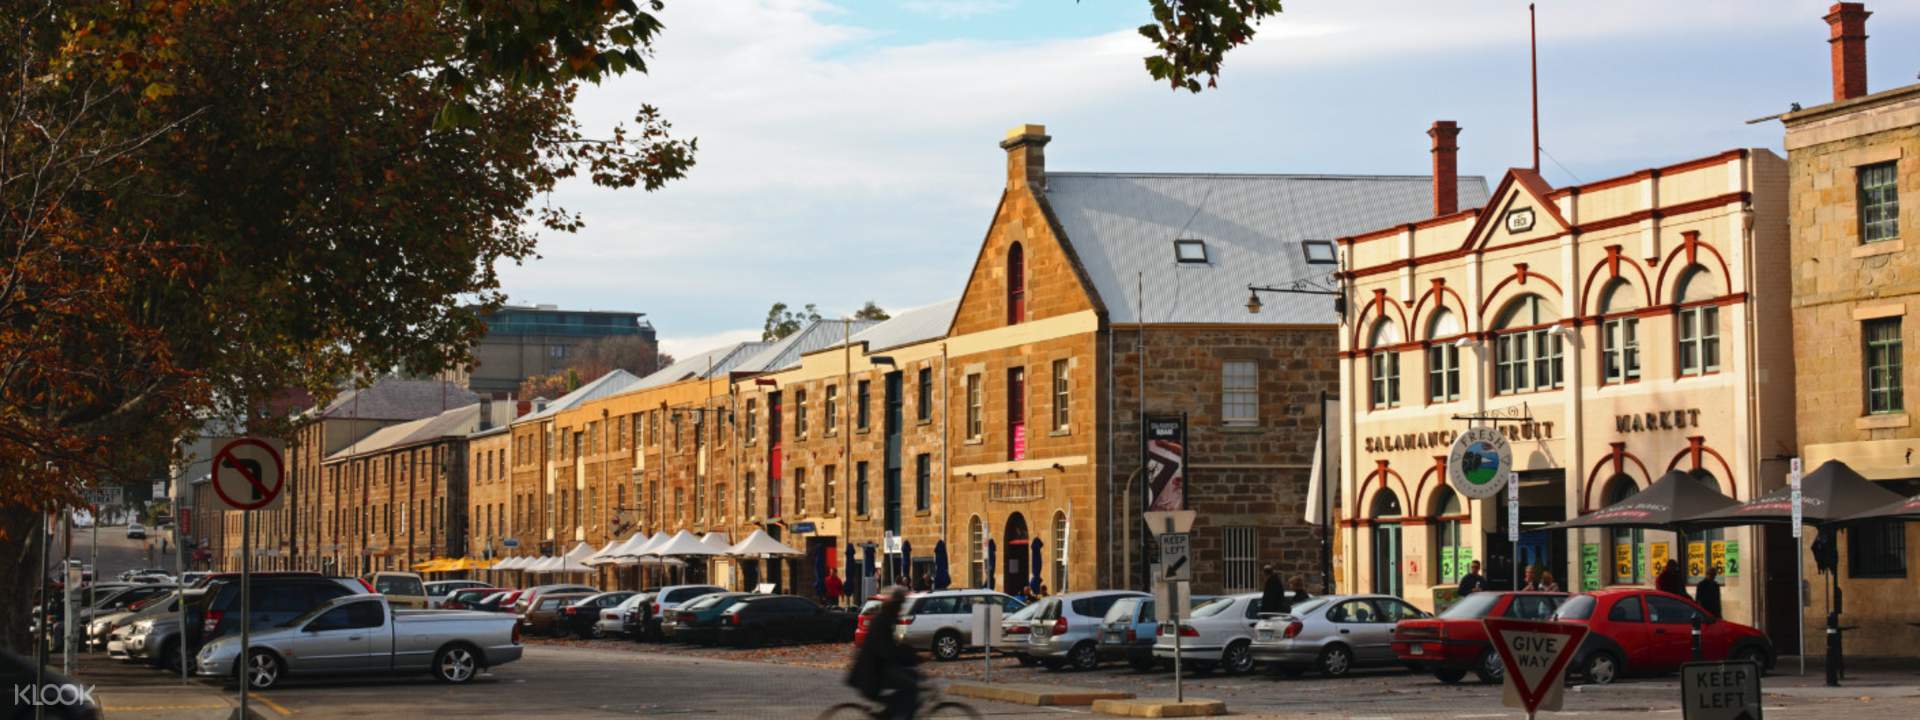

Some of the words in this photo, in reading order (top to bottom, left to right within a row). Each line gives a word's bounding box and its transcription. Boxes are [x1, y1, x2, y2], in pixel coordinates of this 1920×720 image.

[1615, 408, 1701, 433] MARKET
[1460, 429, 1505, 448] FRESH
[1513, 636, 1557, 653] GIVE
[1519, 655, 1549, 668] WAY
[1697, 671, 1746, 688] KEEP
[1700, 692, 1744, 708] LEFT
